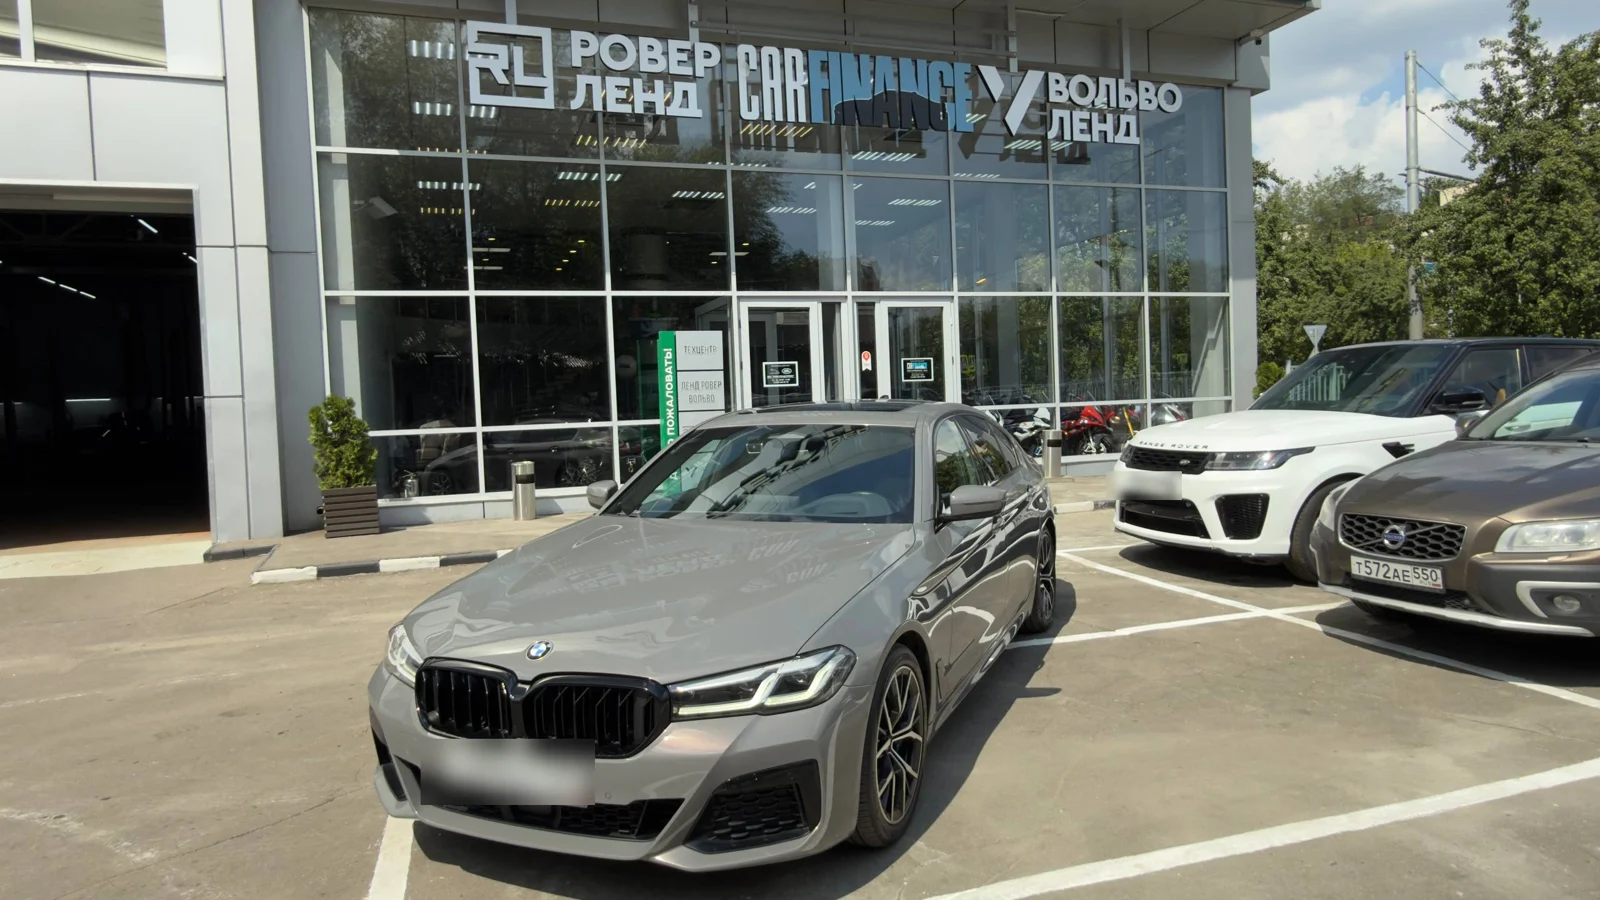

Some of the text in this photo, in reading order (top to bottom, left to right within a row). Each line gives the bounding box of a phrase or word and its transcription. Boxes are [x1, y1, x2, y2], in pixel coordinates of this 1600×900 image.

[570, 30, 721, 77] РОВЕР
[570, 74, 702, 118] ЛЕНД
[1048, 72, 1183, 113] ВОЛЬВО
[1047, 109, 1140, 145] ЛЕНД
[684, 345, 717, 354] ТЕХЦЕНТР
[663, 348, 675, 435] ПОЖАЛОВАТЬ!
[681, 380, 722, 390] ЛЕНД РОВЕР
[688, 394, 716, 403] ВОЛЬВО
[1139, 440, 1165, 448] RANGE
